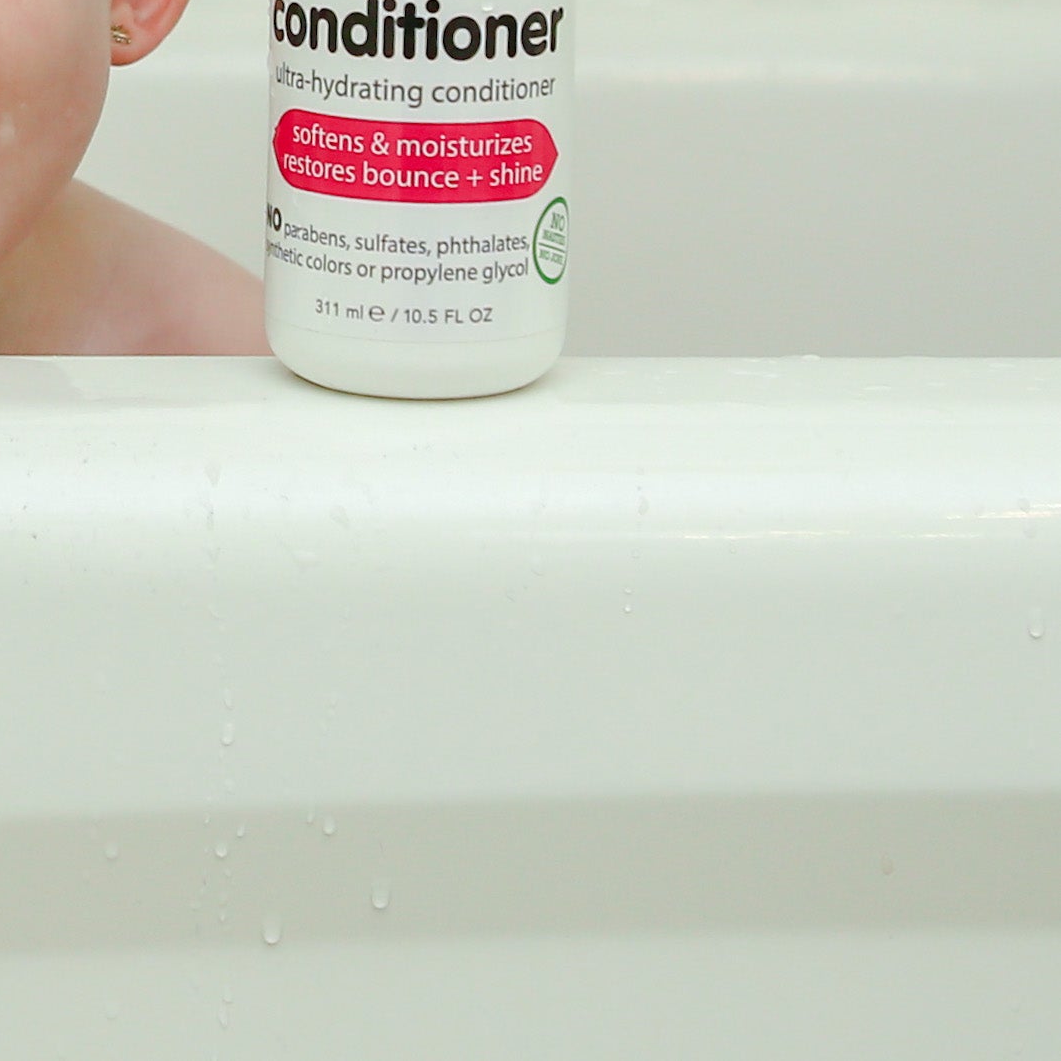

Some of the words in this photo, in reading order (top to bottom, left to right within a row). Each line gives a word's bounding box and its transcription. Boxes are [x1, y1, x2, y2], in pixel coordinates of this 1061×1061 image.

[275, 61, 423, 109] ultra-hydrating
[431, 77, 556, 104] conditioner
[292, 123, 364, 154] softens
[371, 131, 390, 156] &
[396, 133, 533, 159] moisturizes
[282, 153, 356, 183] restores
[362, 161, 459, 189] bounce
[466, 169, 484, 187] +
[489, 161, 544, 187] shine
[283, 222, 350, 251] parabens,
[355, 233, 431, 257] sulfates,
[438, 233, 530, 257] phthalates,
[305, 253, 352, 276] colors
[356, 262, 376, 279] or
[380, 263, 478, 287] propylene
[482, 258, 529, 285] glycol
[315, 298, 340, 317] 311
[346, 303, 363, 320] ml
[390, 307, 398, 323] /
[404, 307, 438, 324] 10.5
[444, 308, 464, 324] FL
[469, 307, 494, 324] OZ
